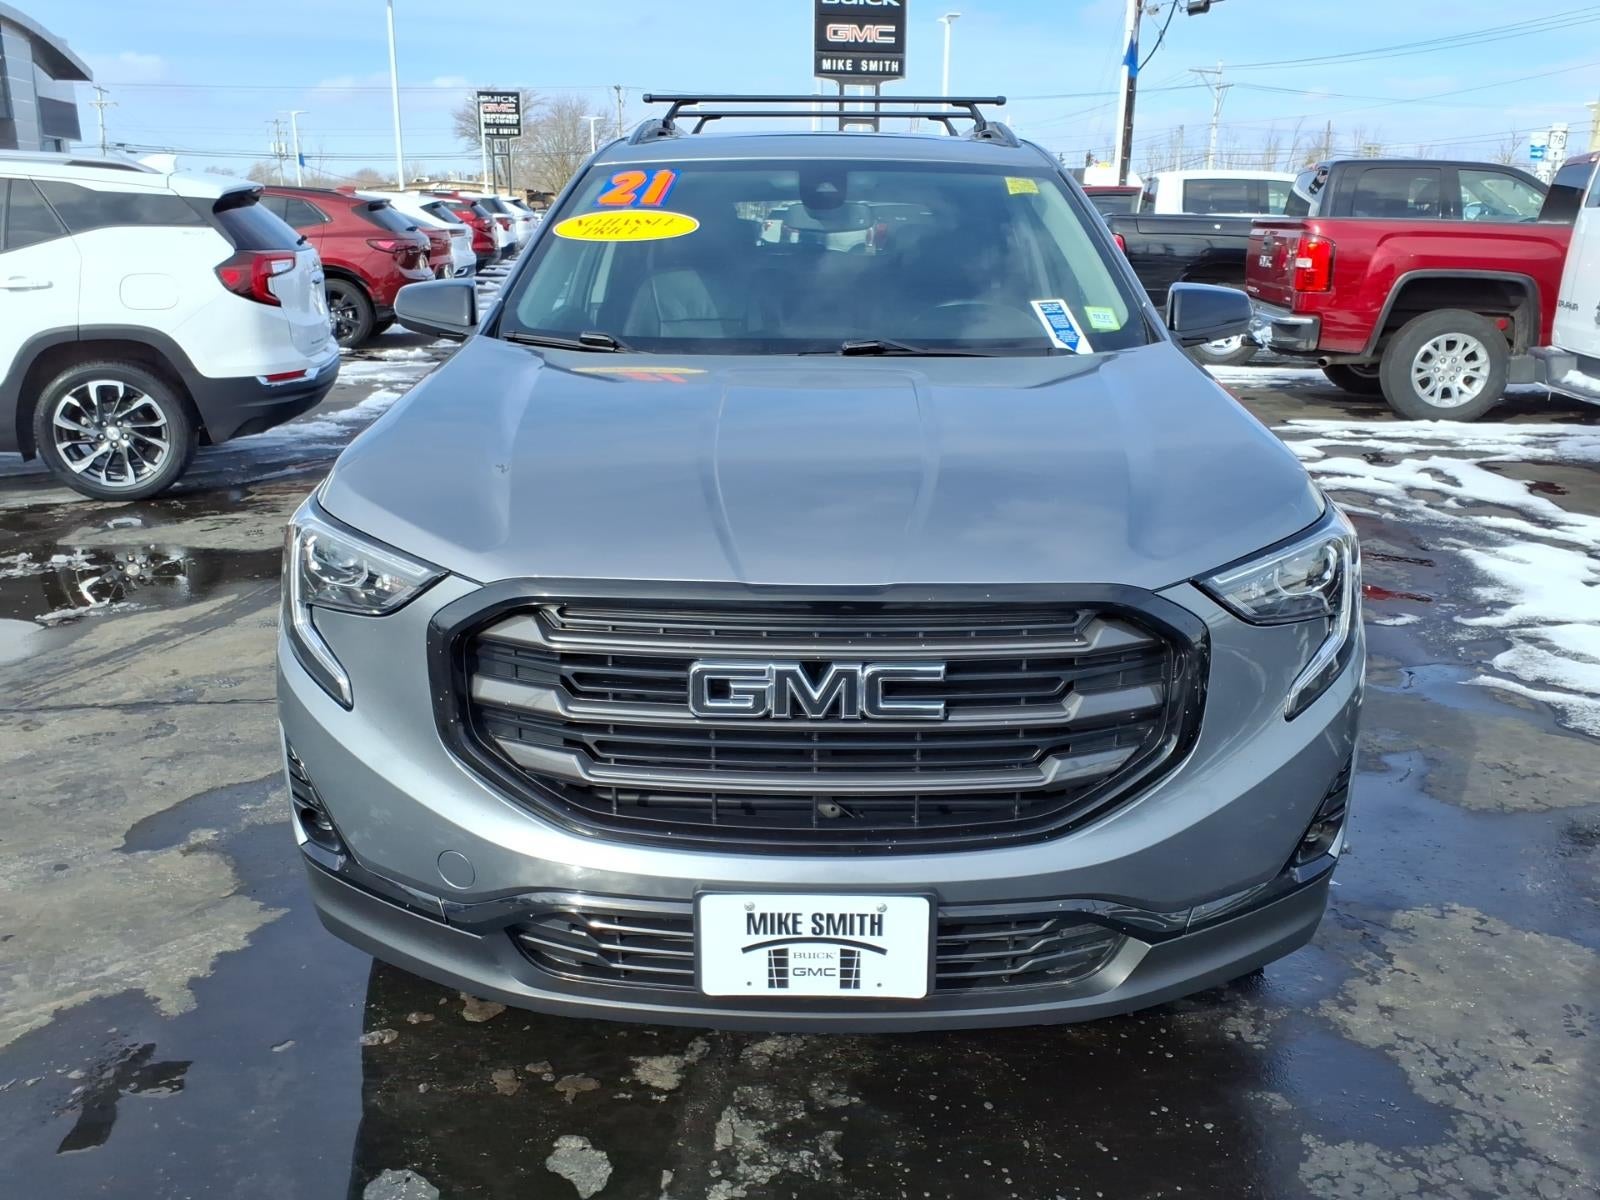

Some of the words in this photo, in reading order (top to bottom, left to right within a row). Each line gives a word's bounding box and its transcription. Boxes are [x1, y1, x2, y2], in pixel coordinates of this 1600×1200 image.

[826, 23, 896, 43] GMC
[821, 59, 853, 71] MIKE
[860, 59, 899, 72] SMITH
[598, 169, 676, 207] 21
[688, 661, 948, 720] GMC
[746, 912, 803, 936] MIKE
[811, 912, 884, 937] SMITH
[793, 951, 833, 960] BUICK
[792, 967, 837, 977] GMC
